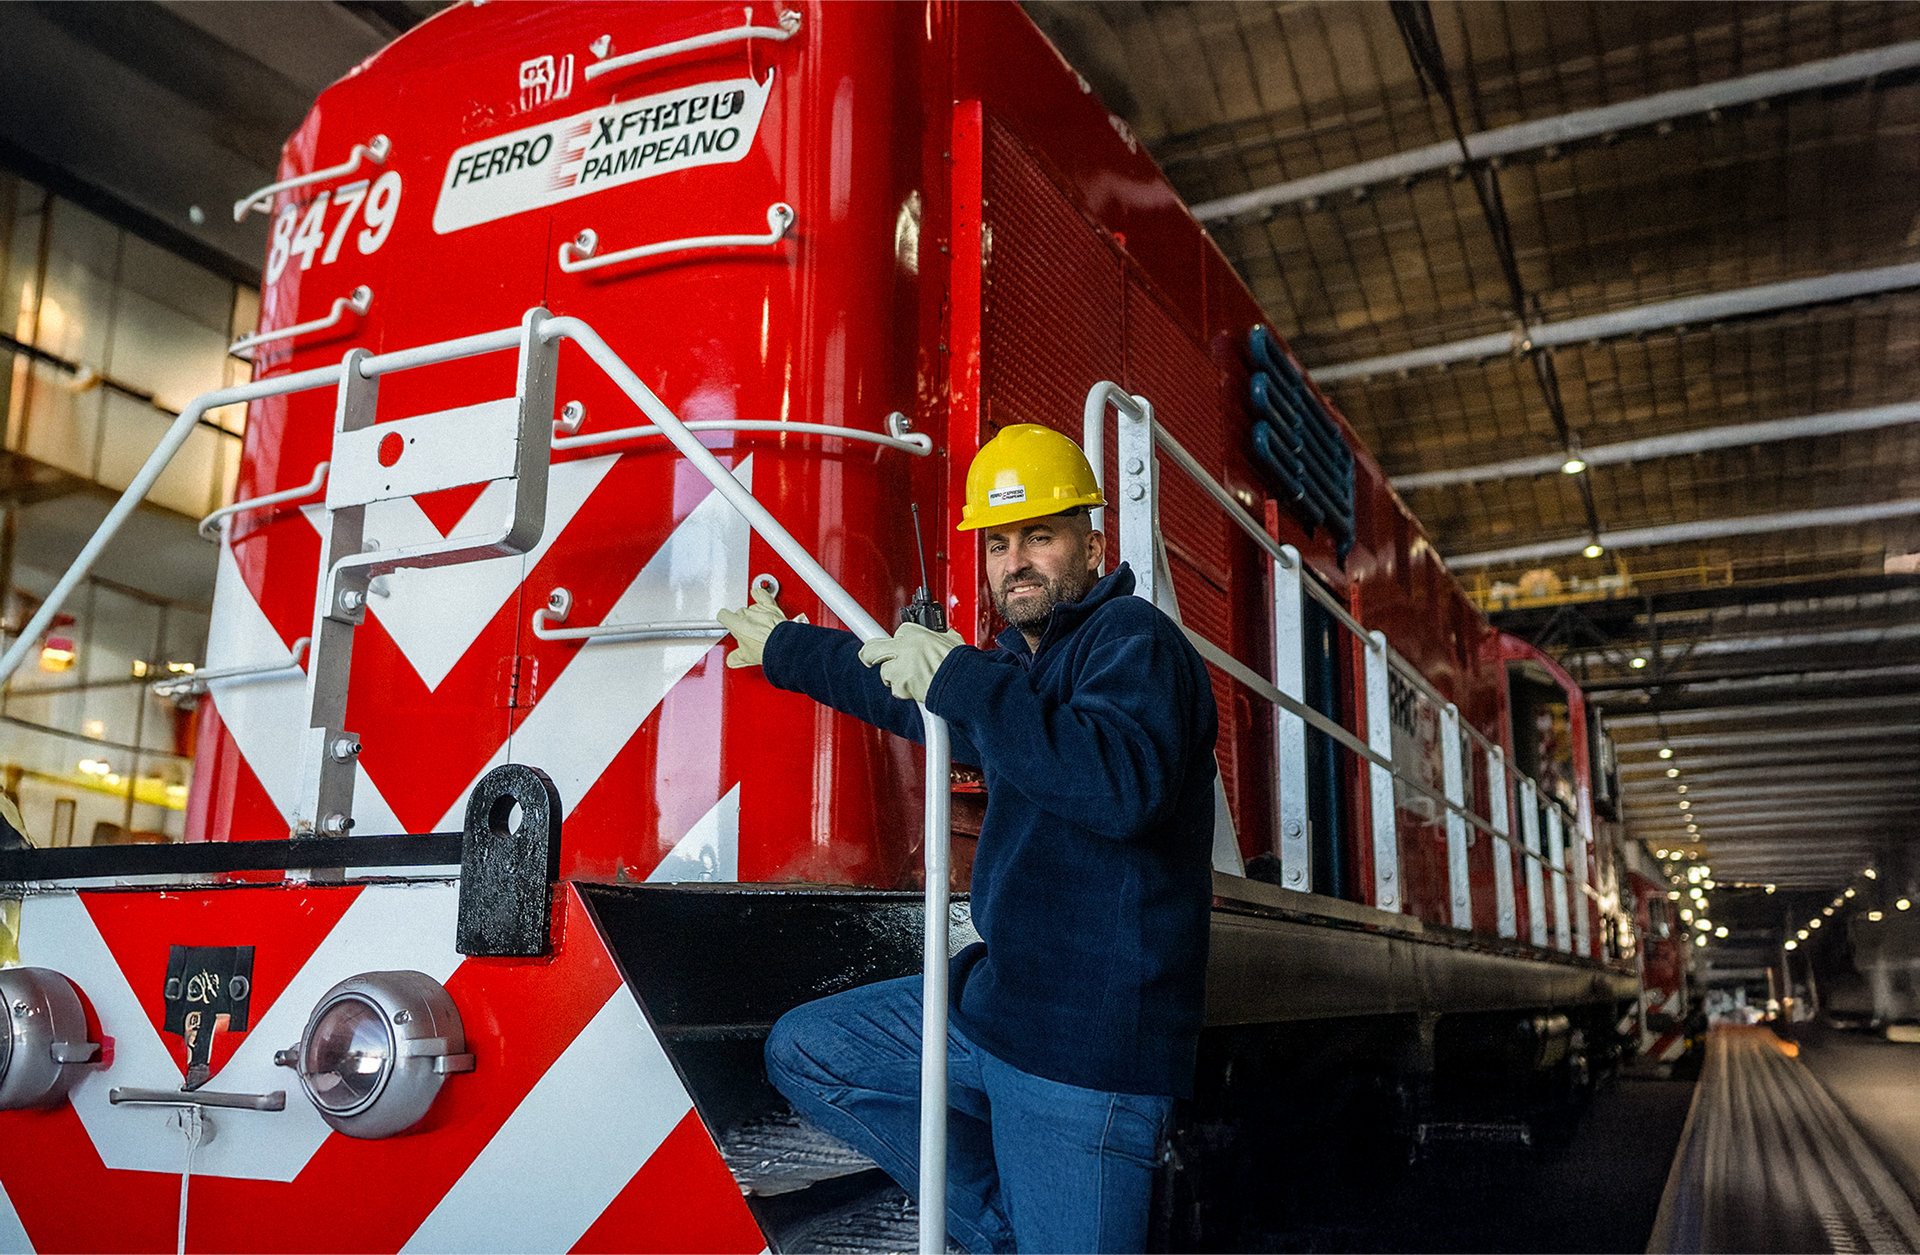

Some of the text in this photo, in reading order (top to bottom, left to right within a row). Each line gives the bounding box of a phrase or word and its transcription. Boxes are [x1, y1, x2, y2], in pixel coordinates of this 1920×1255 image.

[452, 133, 553, 189] FERRO
[580, 127, 740, 184] PAMPEANO
[265, 170, 402, 287] 8479
